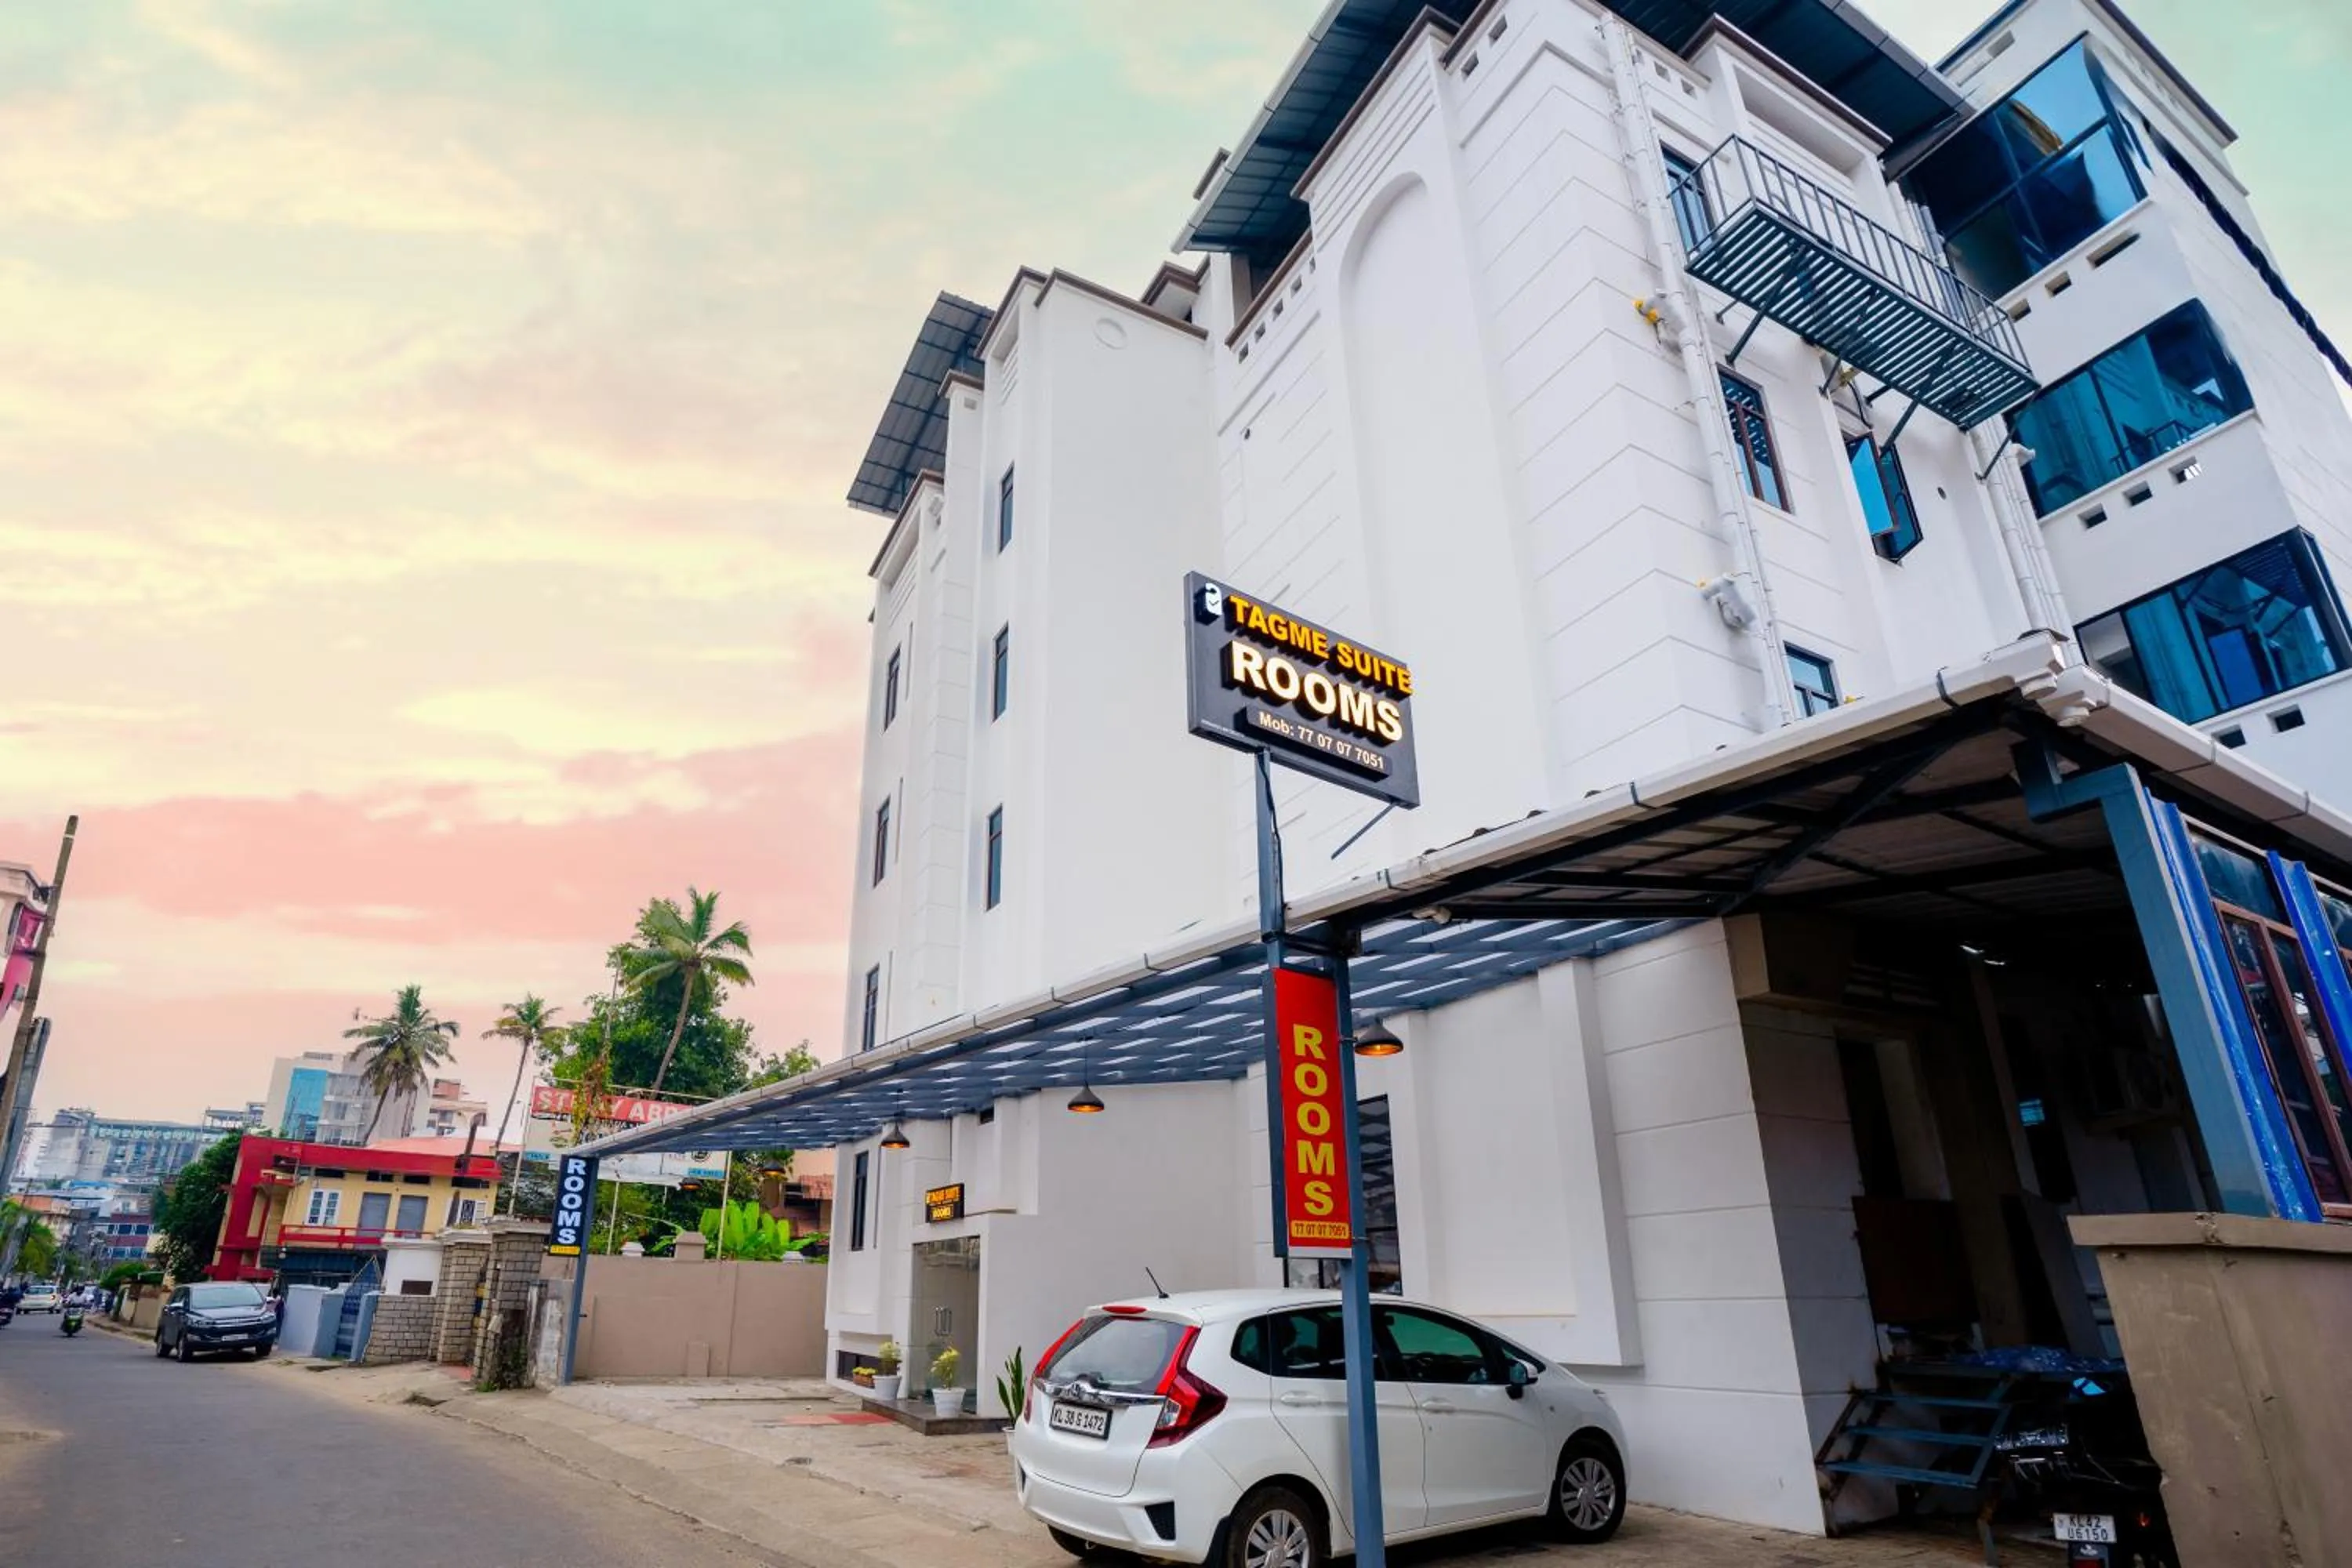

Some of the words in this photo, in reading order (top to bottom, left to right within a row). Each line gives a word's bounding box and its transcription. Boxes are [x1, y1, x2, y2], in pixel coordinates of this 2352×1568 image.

[1229, 595, 1330, 660] TAGME
[1336, 641, 1414, 695] SUITE
[1232, 640, 1403, 742] ROOMS
[1259, 711, 1294, 736] Mob:
[1298, 724, 1315, 744] 77
[1317, 733, 1334, 751] 07
[1337, 740, 1352, 758] 07
[1356, 747, 1384, 770] 7051
[1293, 1023, 1335, 1216] ROOMS
[557, 1158, 586, 1245] ROOMS
